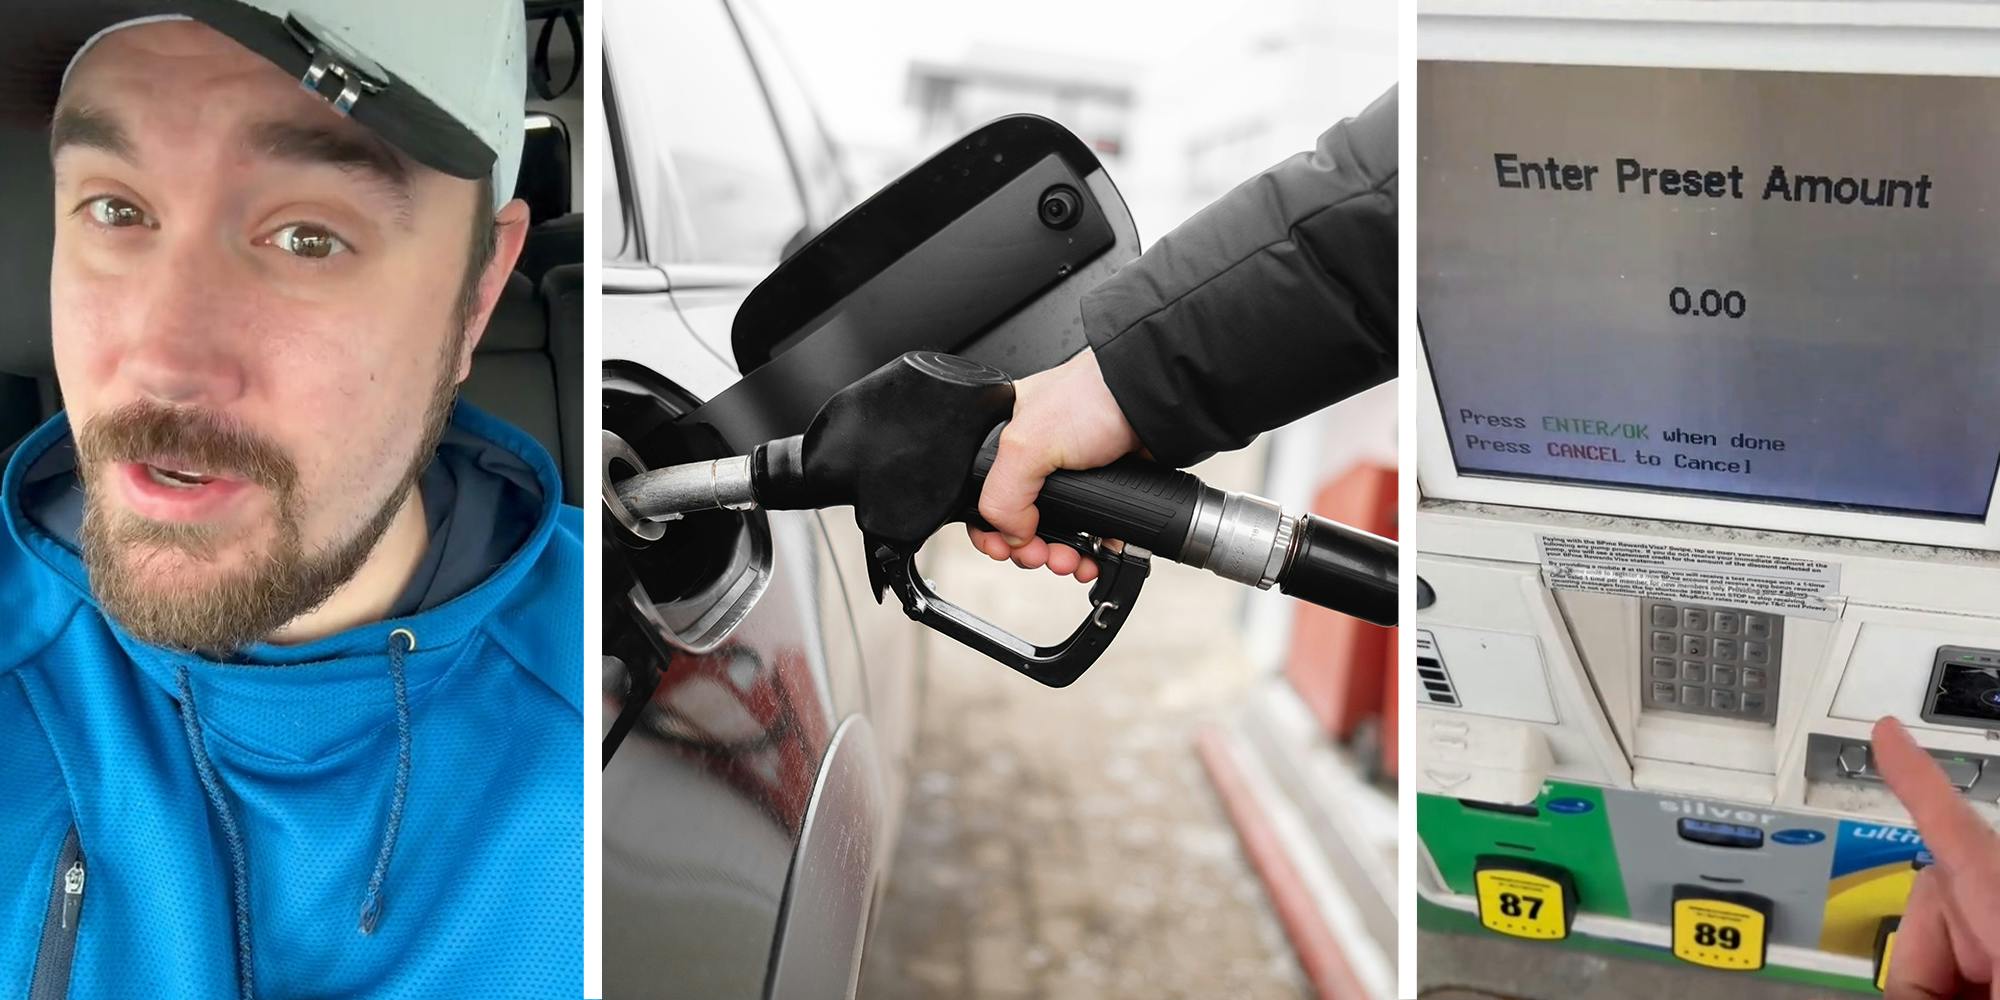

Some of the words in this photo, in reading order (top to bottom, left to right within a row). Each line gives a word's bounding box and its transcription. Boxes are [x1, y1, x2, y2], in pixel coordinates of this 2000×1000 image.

[1494, 153, 1599, 191] Enter
[1616, 158, 1744, 199] Preset
[1762, 165, 1933, 208] Amount
[1669, 287, 1746, 319] 0.00
[1459, 408, 1527, 429] Press
[1541, 416, 1649, 440] ENTER/OK
[1662, 428, 1717, 447] when
[1730, 433, 1785, 451] done
[1465, 434, 1532, 455] Press
[1546, 442, 1626, 463] CANCEL
[1635, 450, 1661, 466] to
[1674, 453, 1751, 474] Cancel
[1659, 800, 1777, 824] silver
[1500, 892, 1543, 919] 87
[1694, 923, 1740, 950] 89
